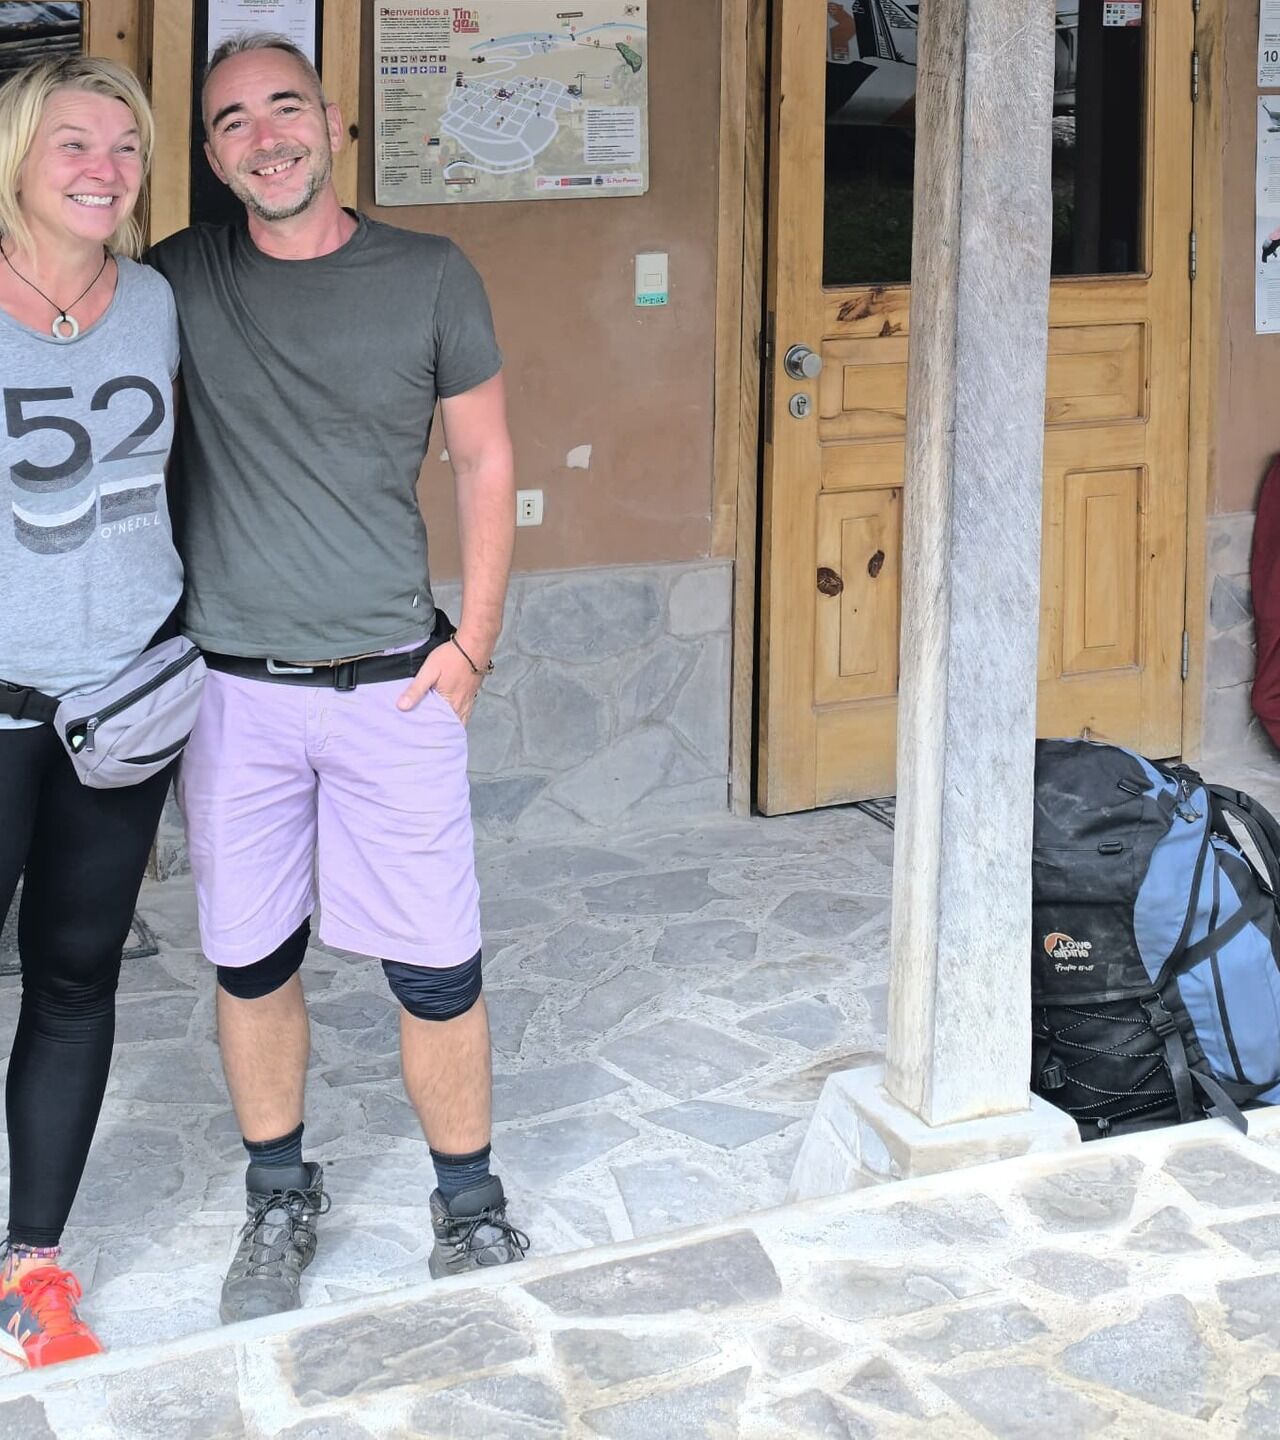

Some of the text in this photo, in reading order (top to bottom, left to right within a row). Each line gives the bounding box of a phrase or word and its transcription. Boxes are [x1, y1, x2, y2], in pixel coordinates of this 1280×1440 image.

[380, 8, 440, 17] Bienvenidos
[1263, 50, 1279, 62] 10
[3, 375, 169, 492] 52
[100, 515, 162, 539] O'NEILL
[1059, 940, 1092, 950] Lowe
[1053, 948, 1089, 960] alpine
